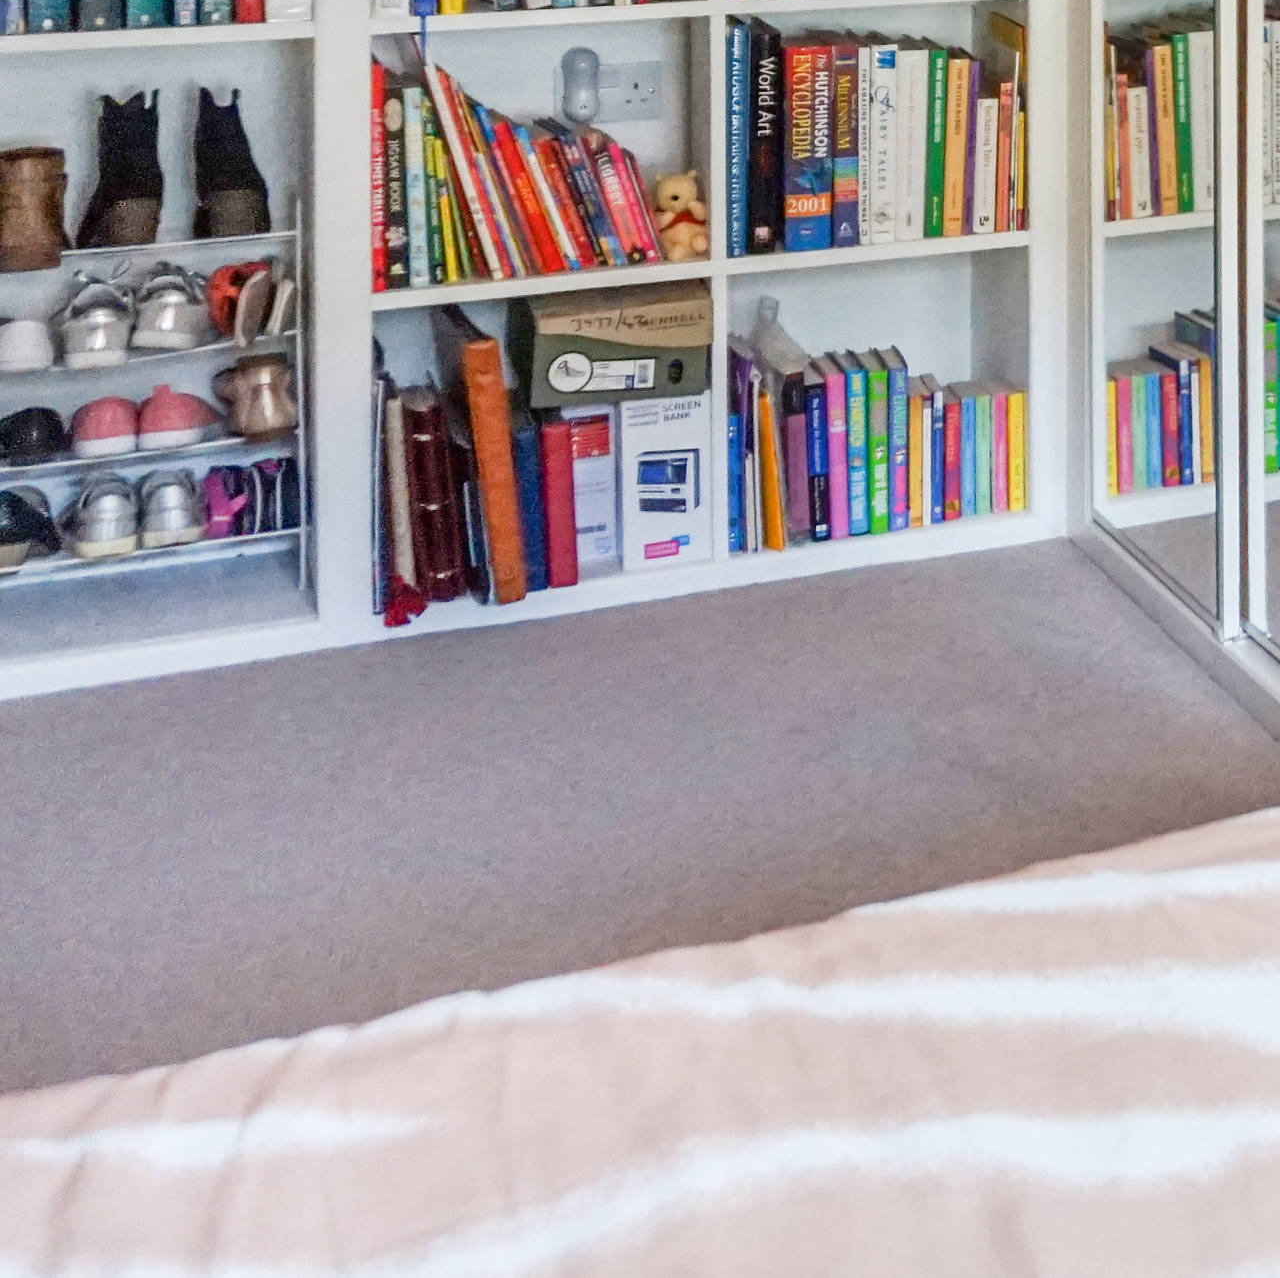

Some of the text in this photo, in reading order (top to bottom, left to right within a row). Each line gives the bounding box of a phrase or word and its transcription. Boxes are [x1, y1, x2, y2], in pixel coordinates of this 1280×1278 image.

[733, 60, 743, 96] ATLAS
[757, 57, 776, 137] World Art
[792, 54, 812, 159] ENCYCLOPEDIA
[814, 54, 828, 158] The HUTCHINSON
[837, 74, 851, 150] MILLENNIUM
[732, 114, 743, 164] BRITAIN
[874, 85, 896, 191] FAIRY TALES
[983, 105, 993, 168] Enchanting Tales
[372, 156, 383, 185] TIMES
[387, 139, 401, 212] JIGSAW BOOK
[597, 157, 623, 206] LIONBOY
[372, 187, 383, 222] TABLES
[786, 197, 829, 215] 2001
[662, 400, 702, 412] SCREEN
[663, 412, 691, 422] BANK
[812, 397, 820, 408] The
